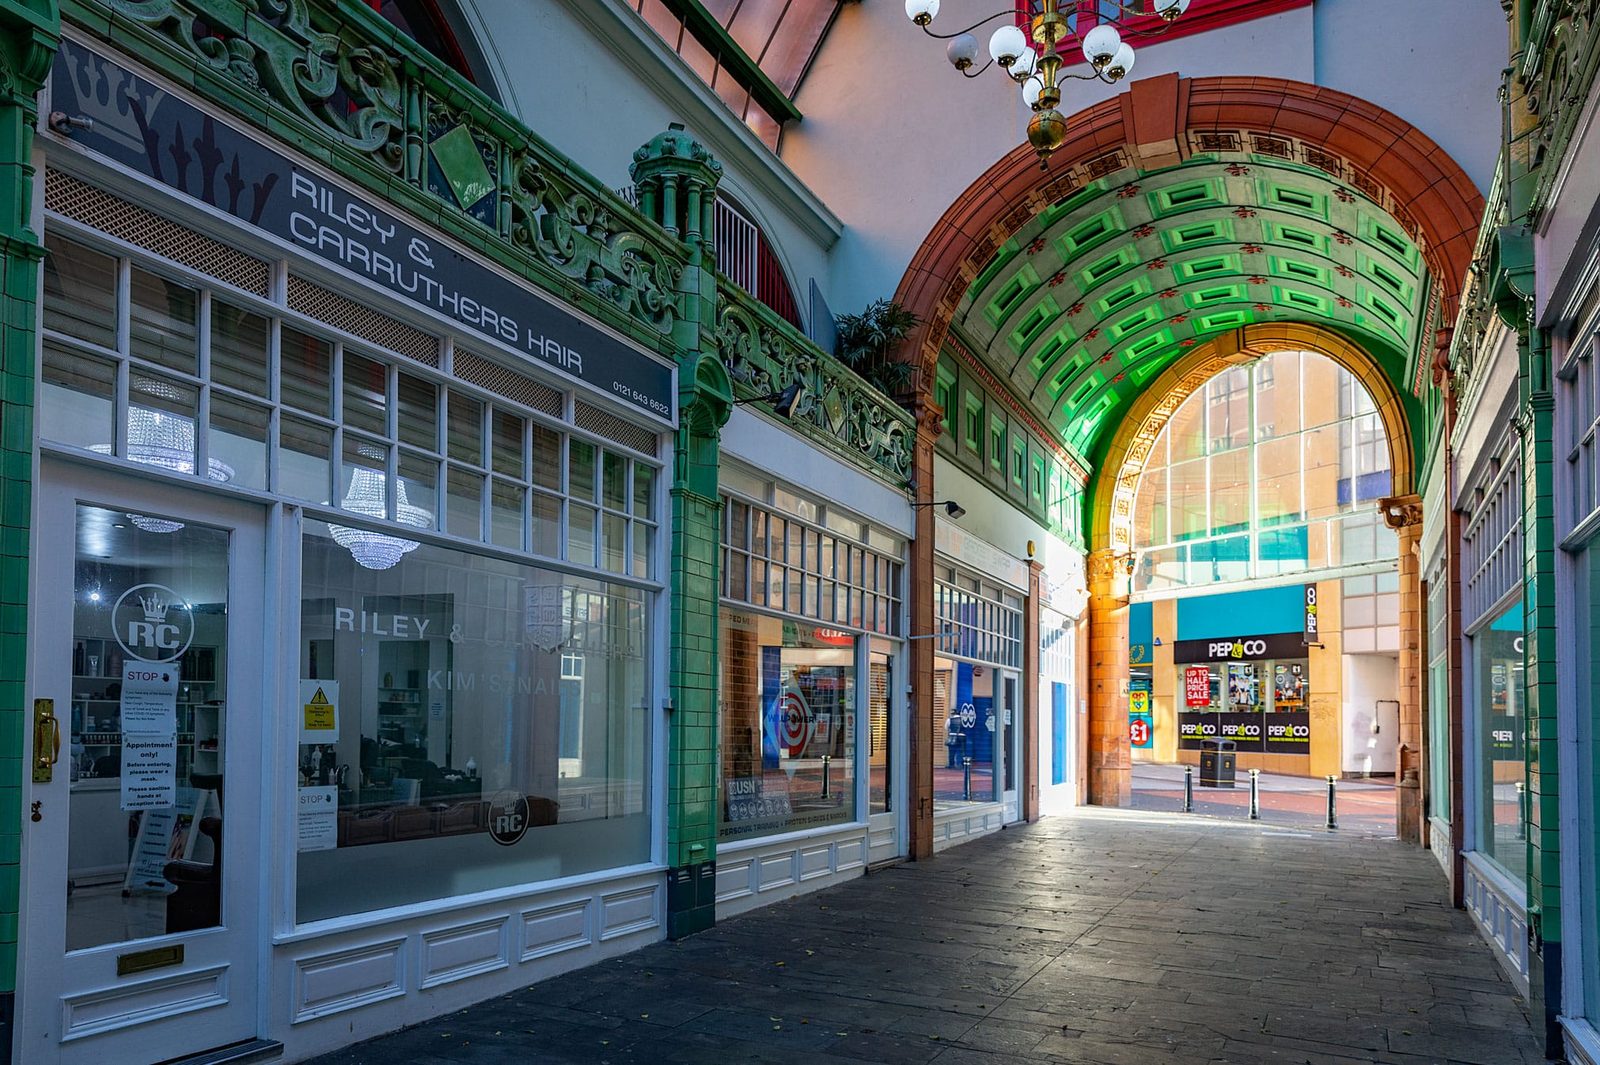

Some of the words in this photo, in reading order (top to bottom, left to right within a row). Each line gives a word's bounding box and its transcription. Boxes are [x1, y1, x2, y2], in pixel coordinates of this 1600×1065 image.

[291, 171, 396, 245] RILEY
[408, 237, 435, 269] &
[290, 211, 519, 342] CARRUTHERS
[528, 328, 583, 374] HAIR
[613, 380, 631, 397] 0121
[632, 390, 649, 406] 643
[649, 398, 670, 415] 6622
[335, 606, 431, 639] RILEY
[450, 623, 465, 644] &
[128, 621, 180, 649] RC
[128, 671, 159, 681] STOP
[428, 668, 500, 694] KIM'S
[1186, 677, 1208, 685] HALF
[1187, 691, 1209, 699] SALE
[1130, 723, 1148, 741] £1
[126, 742, 173, 750] Appointment
[736, 780, 755, 795] USN
[300, 794, 323, 804] STOP
[496, 814, 522, 834] RC
